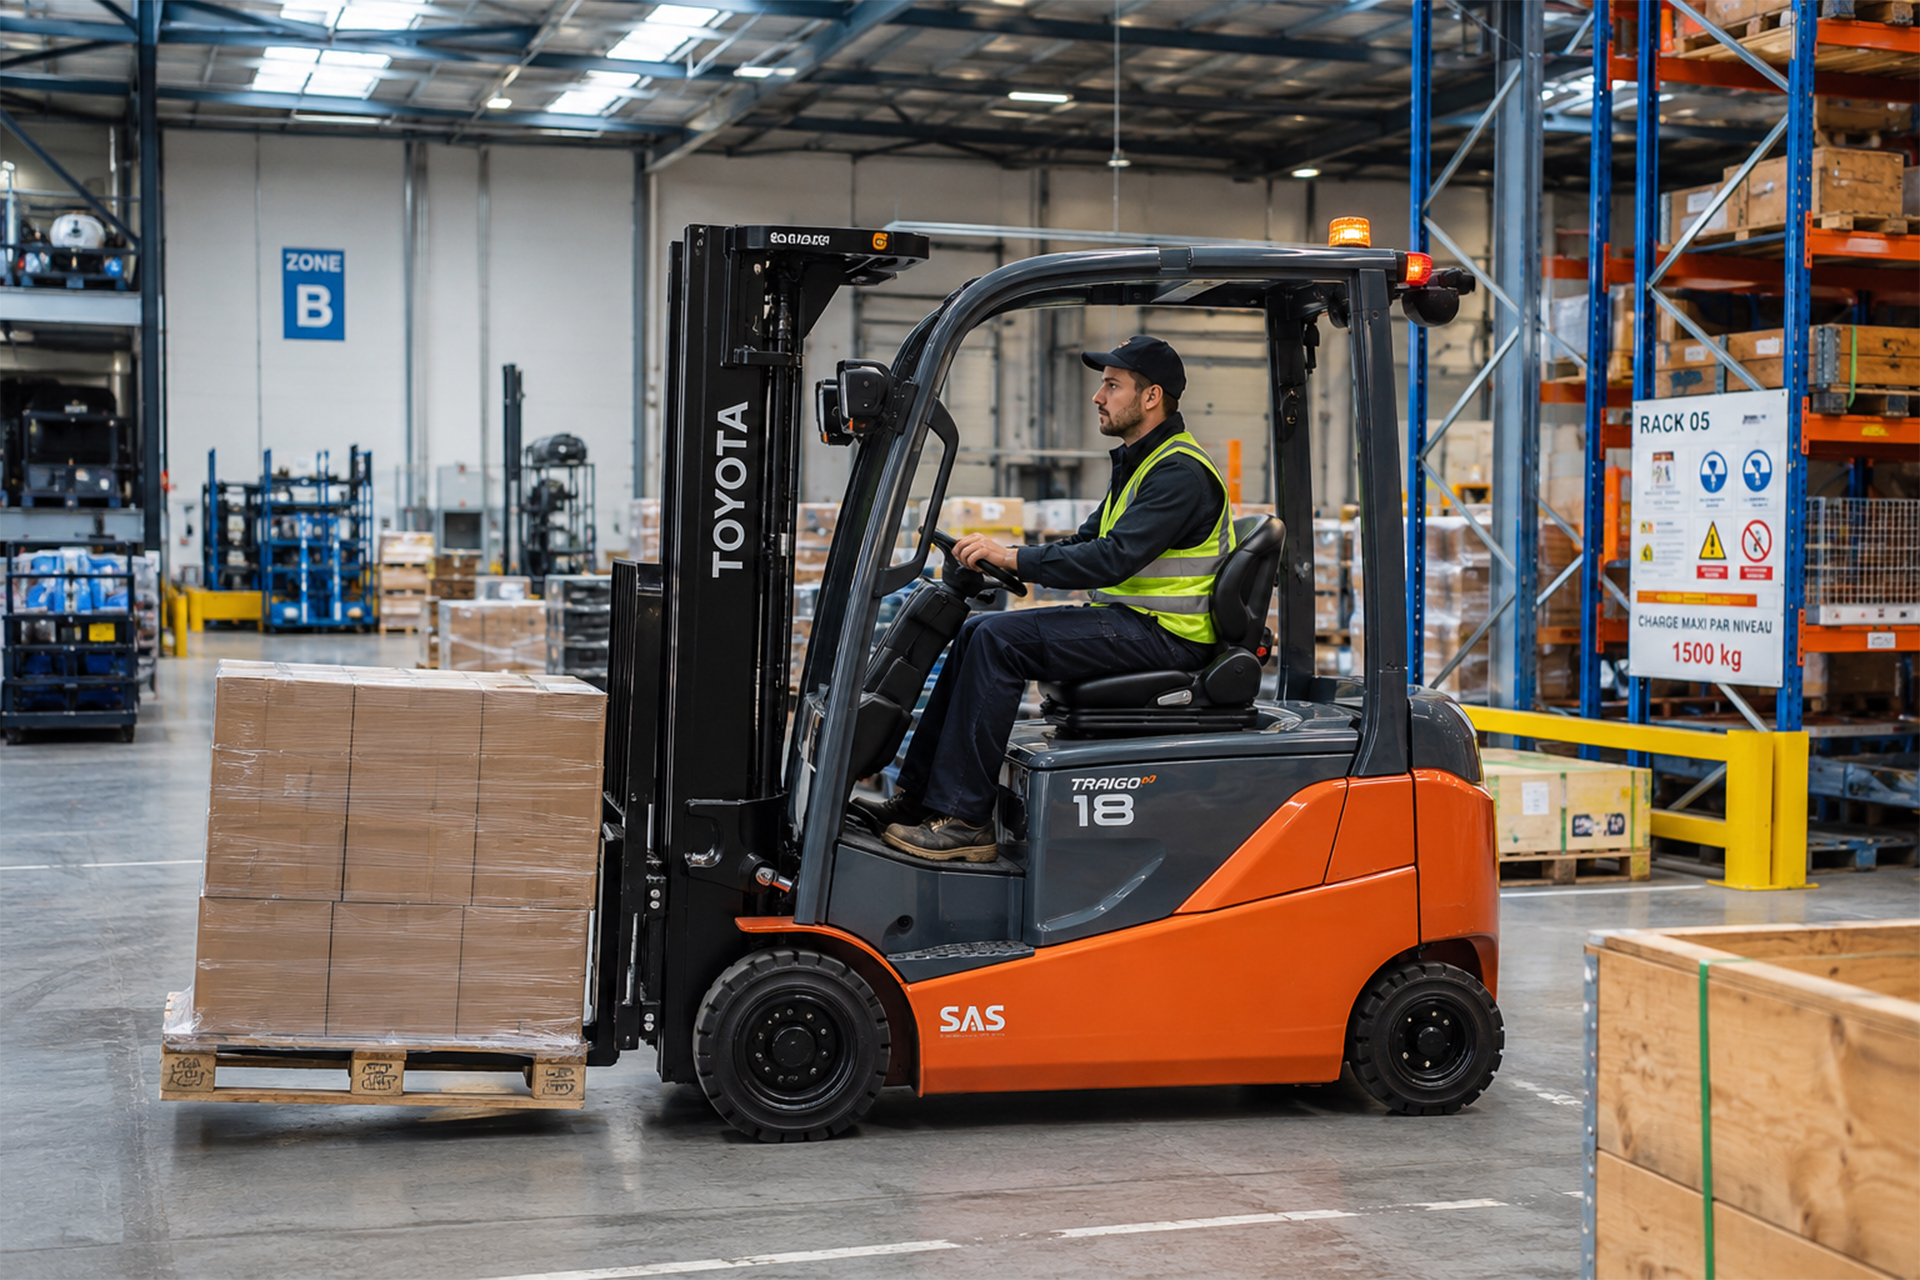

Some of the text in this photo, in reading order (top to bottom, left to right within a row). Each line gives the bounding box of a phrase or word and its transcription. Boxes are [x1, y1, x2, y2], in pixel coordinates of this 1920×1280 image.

[286, 253, 341, 272] ZONE
[297, 284, 333, 328] B
[1640, 411, 1710, 434] RACK 05
[712, 401, 749, 578] TOYOTA
[1638, 615, 1773, 634] CHARGE MAXI PAR NIVEAU
[1672, 641, 1742, 672] 1500 kg
[1071, 777, 1141, 791] TRAIGO
[1073, 794, 1134, 827] 18
[940, 1005, 1006, 1032] SAS
